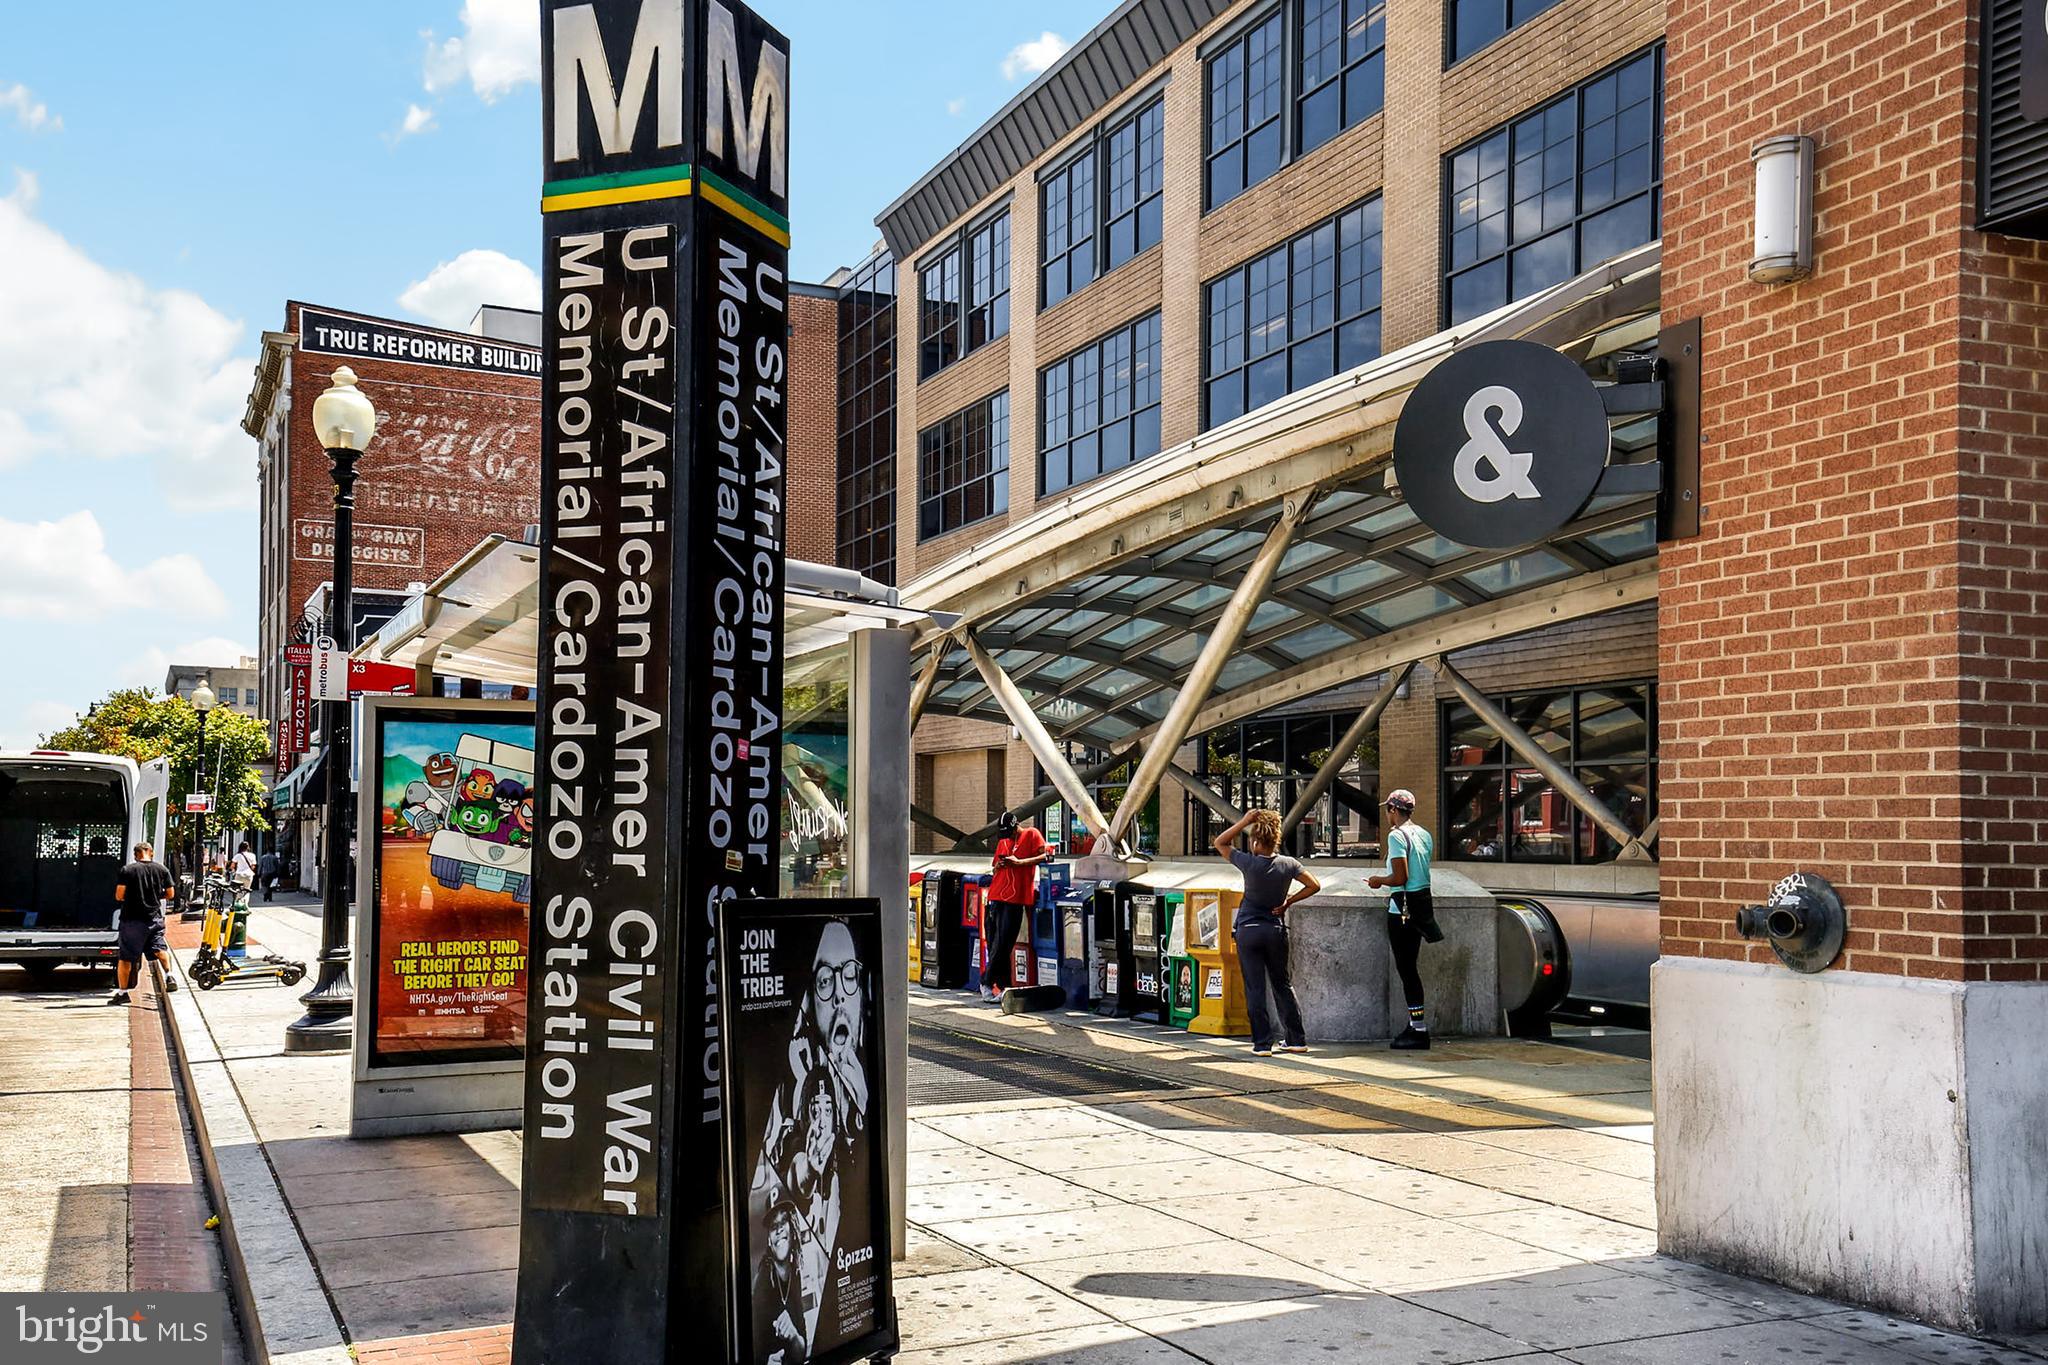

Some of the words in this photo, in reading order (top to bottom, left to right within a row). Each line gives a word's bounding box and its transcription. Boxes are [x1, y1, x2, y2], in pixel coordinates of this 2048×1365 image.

[553, 0, 682, 162] M
[706, 0, 786, 199] M
[622, 224, 669, 272] U
[756, 262, 783, 313] U
[315, 326, 369, 351] TRUE
[373, 333, 475, 364] REFORMER
[302, 524, 335, 540] GRA
[371, 530, 417, 546] GRAY
[311, 543, 410, 562] DRGGISTS
[549, 232, 605, 860] Memorial/Cardozo
[708, 237, 748, 848] Memorial/Cardozo
[612, 305, 672, 878] St/African-Amer
[748, 335, 783, 866] St/African-Amer
[287, 647, 312, 655] ITALIA
[352, 664, 366, 673] X3
[318, 652, 328, 697] metrobus
[295, 669, 306, 749] ALPHONSE
[278, 721, 289, 773] AMSTERDAM
[401, 942, 435, 957] REAL
[437, 940, 487, 956] HEROES
[490, 939, 520, 954] FIND
[740, 929, 775, 950] JOIN
[393, 959, 417, 974] THE
[420, 958, 461, 974] RIGHT
[464, 957, 491, 972] CAR
[494, 956, 527, 971] SEAT
[404, 974, 453, 990] BEFORE
[456, 973, 488, 988] THEY
[491, 972, 515, 987] GO!
[607, 909, 658, 1052] Civil
[740, 953, 770, 974] THE
[409, 991, 508, 1006] NHTSA.gov/TheRightSeat
[741, 975, 784, 998] TRIBE
[540, 894, 593, 1139] Station
[602, 1084, 653, 1217] War
[837, 1246, 873, 1272] &pizza
